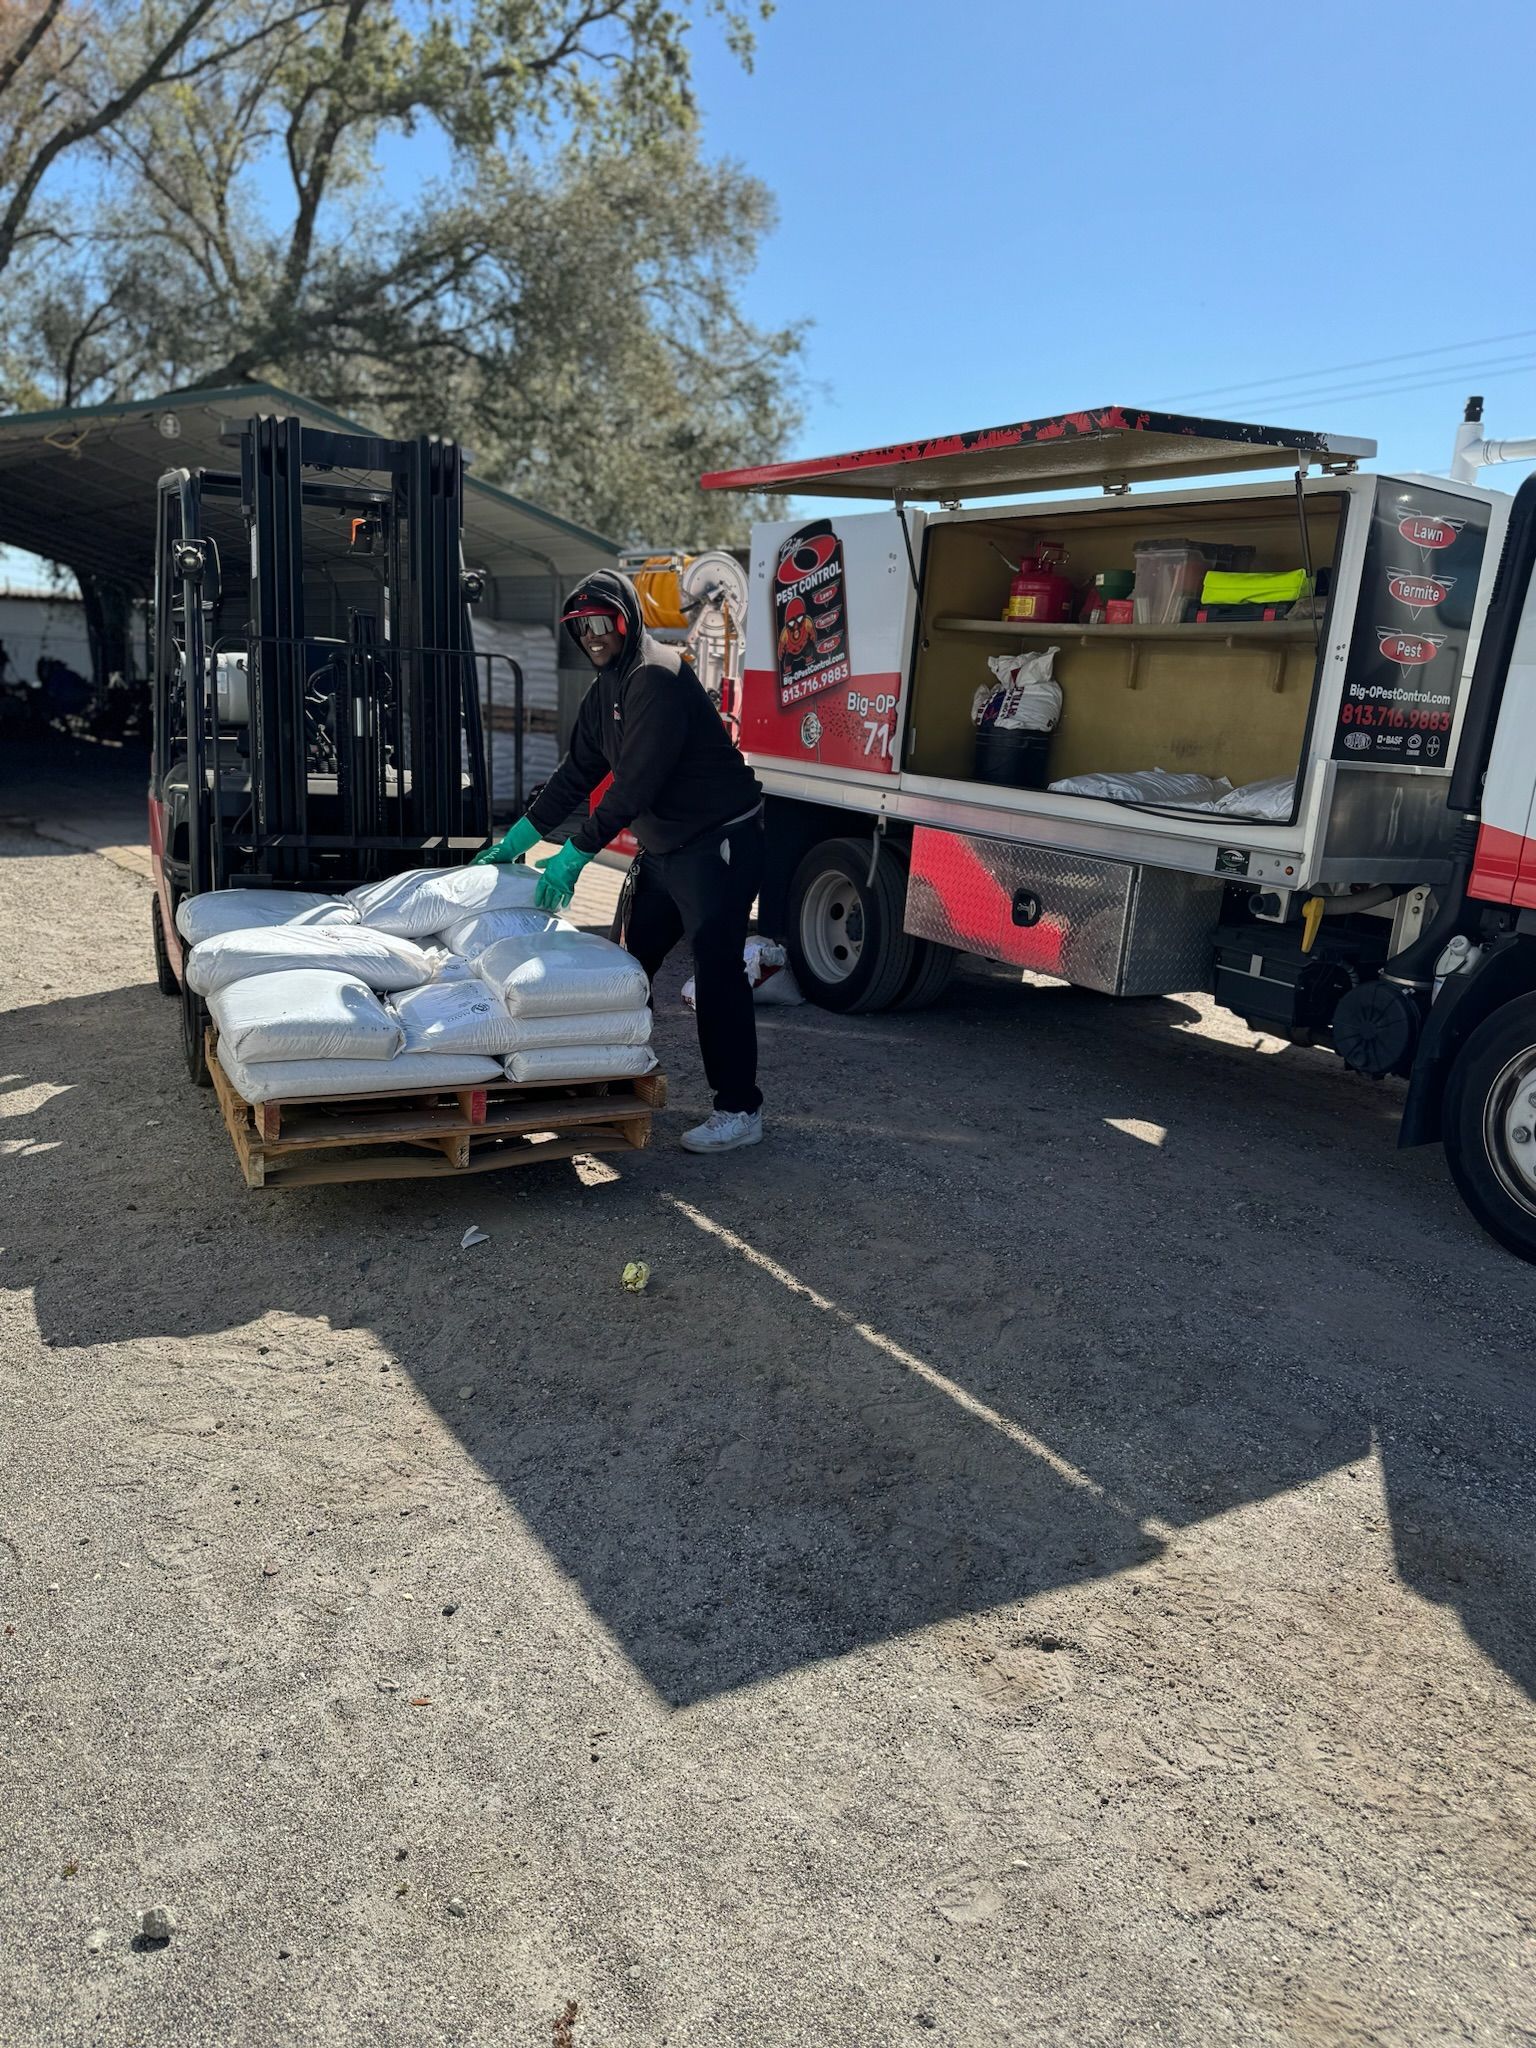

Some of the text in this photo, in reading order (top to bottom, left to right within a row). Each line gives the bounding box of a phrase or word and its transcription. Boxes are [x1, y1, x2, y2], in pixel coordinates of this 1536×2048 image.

[1413, 522, 1443, 542] Lawn
[776, 561, 842, 607] PEST CONTROL
[1398, 580, 1440, 602] Termite
[1396, 641, 1422, 658] Pest
[782, 663, 848, 703] 813.716.9883
[1349, 683, 1451, 705] Big-OPestControl.com
[1341, 703, 1451, 732] 813.716.9883
[863, 721, 889, 758] 71
